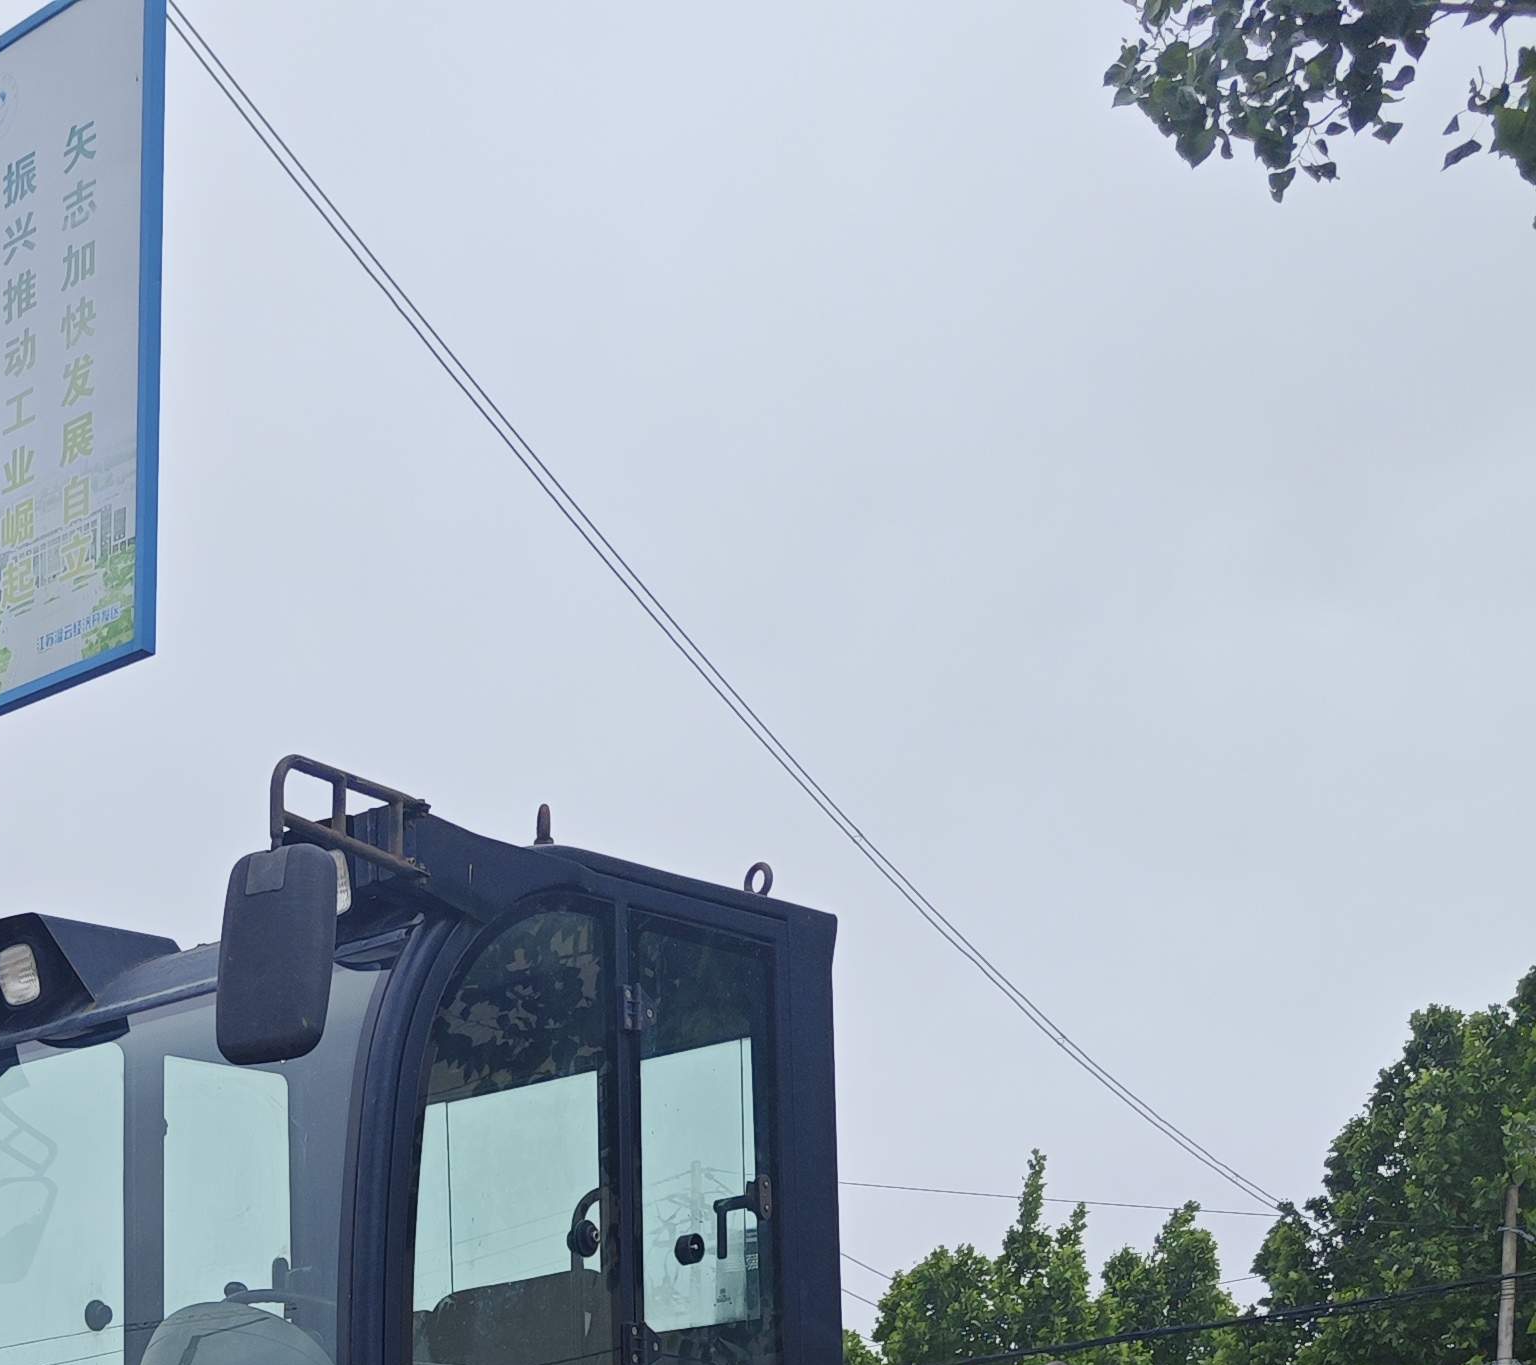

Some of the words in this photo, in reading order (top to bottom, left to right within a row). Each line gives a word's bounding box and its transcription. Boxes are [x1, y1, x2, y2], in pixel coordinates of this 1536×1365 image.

[1, 151, 38, 606] 振兴推动工业崛起
[61, 120, 97, 582] 矢志加快发展自立
